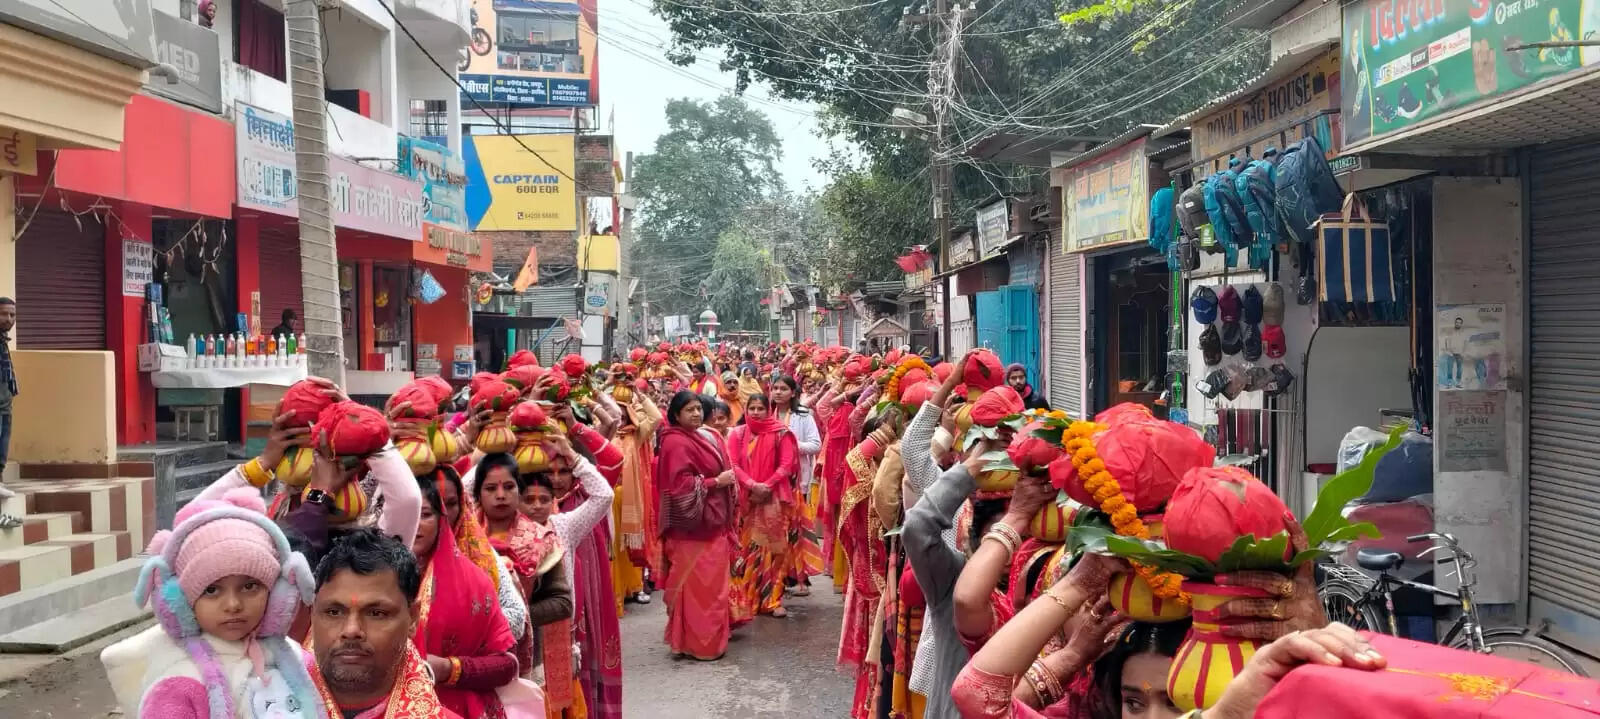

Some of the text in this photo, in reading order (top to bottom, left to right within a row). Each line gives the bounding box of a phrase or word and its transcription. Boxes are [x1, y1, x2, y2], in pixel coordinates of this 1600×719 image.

[1268, 71, 1312, 119] HOUSE
[493, 174, 559, 184] CAPTAIN
[516, 185, 537, 194] 600
